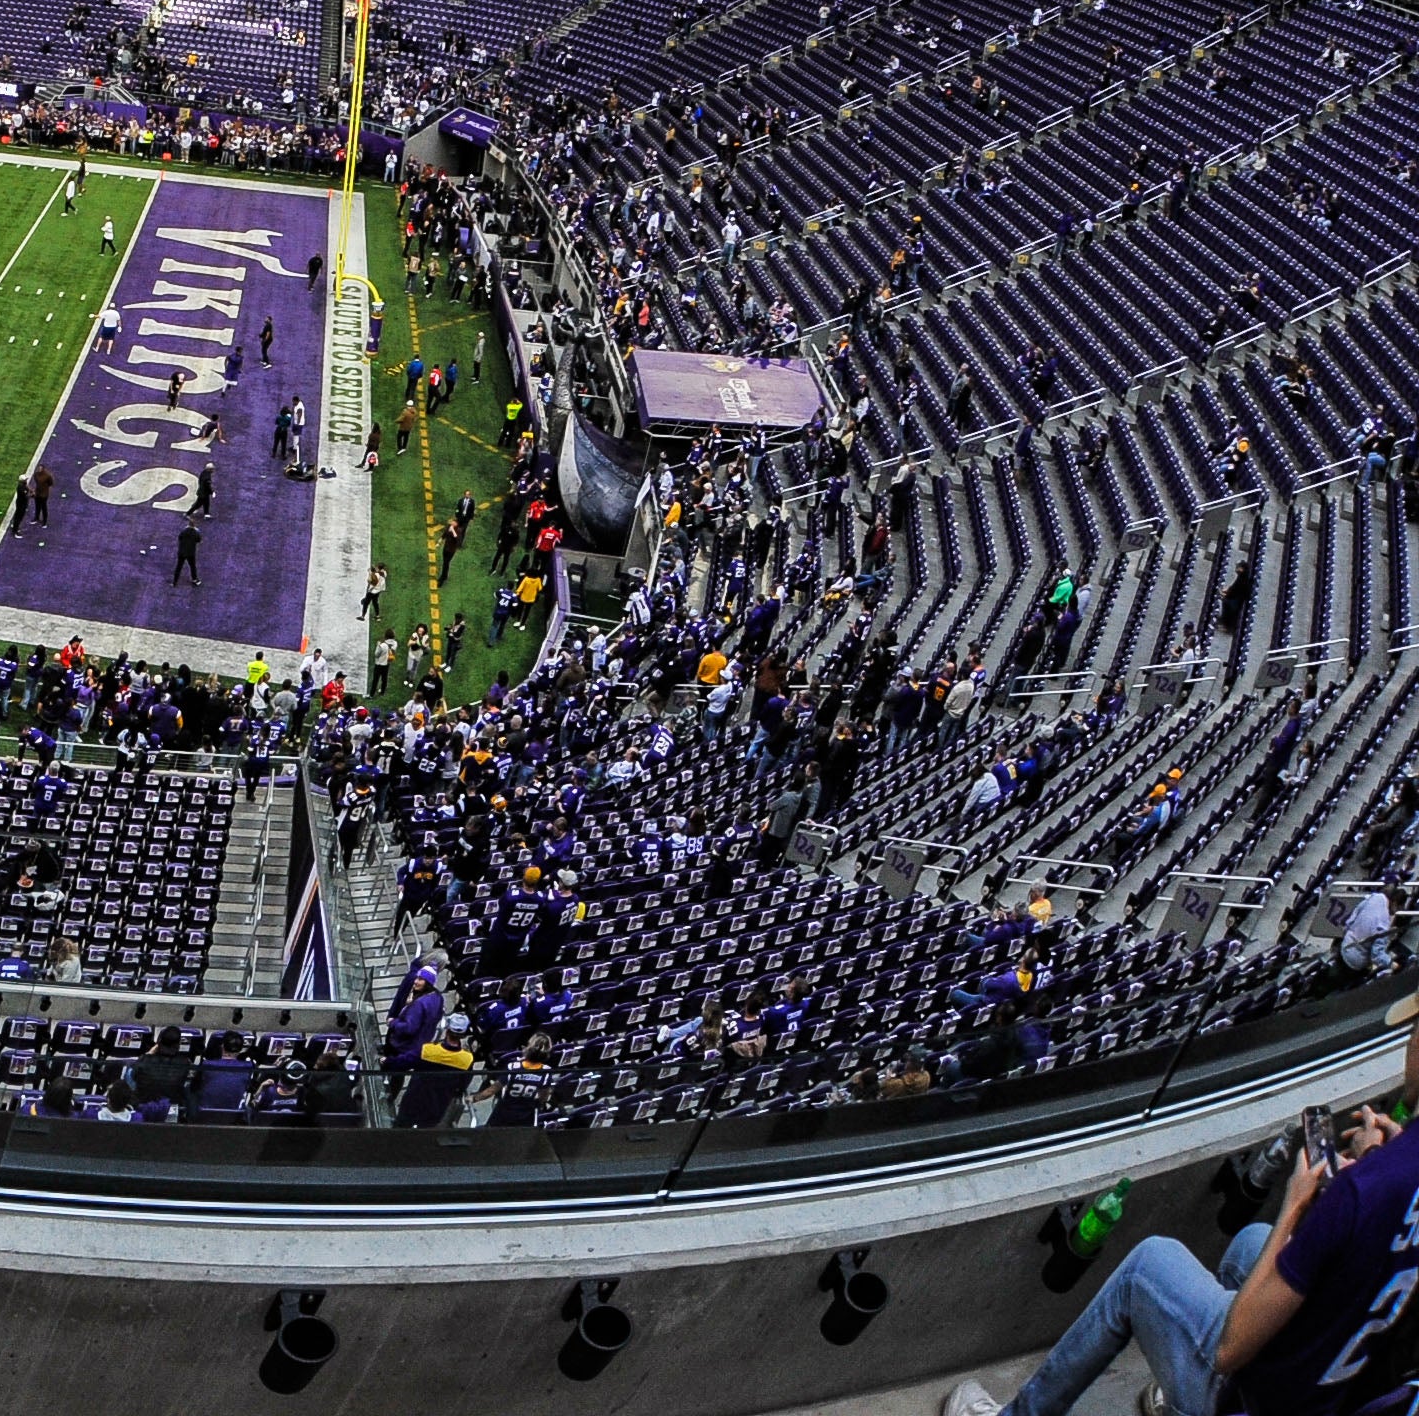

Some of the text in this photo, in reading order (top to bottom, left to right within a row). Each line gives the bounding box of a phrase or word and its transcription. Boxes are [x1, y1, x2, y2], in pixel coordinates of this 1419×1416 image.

[70, 227, 310, 513] VIKINGS
[328, 284, 363, 446] SALUTE TO SERVICE
[717, 386, 740, 419] stadium
[1156, 674, 1176, 697] 124
[1267, 665, 1285, 681] 124
[795, 832, 815, 861] 124
[893, 852, 913, 880] 124
[509, 912, 536, 926] 28
[1183, 887, 1209, 922] 124
